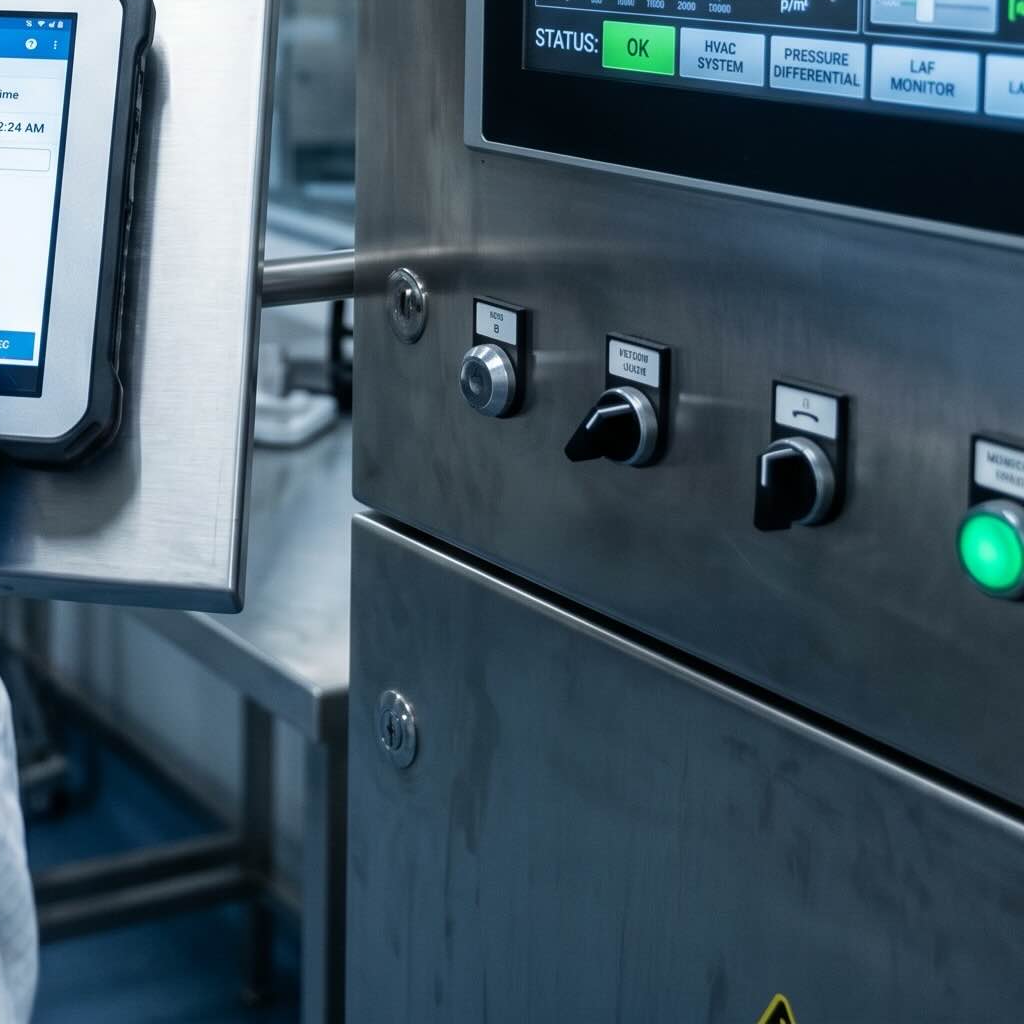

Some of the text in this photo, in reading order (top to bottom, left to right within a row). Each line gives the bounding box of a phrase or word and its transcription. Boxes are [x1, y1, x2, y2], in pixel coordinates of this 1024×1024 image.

[535, 27, 650, 58] STATUS: OK
[705, 40, 736, 55] HVAC
[698, 57, 744, 73] SYSTEM
[784, 47, 849, 66] PRESSURE
[910, 59, 935, 75] LAF
[774, 65, 860, 87] DIFFERENTIAL
[890, 77, 955, 97] MONITOR
[25, 123, 45, 133] AM
